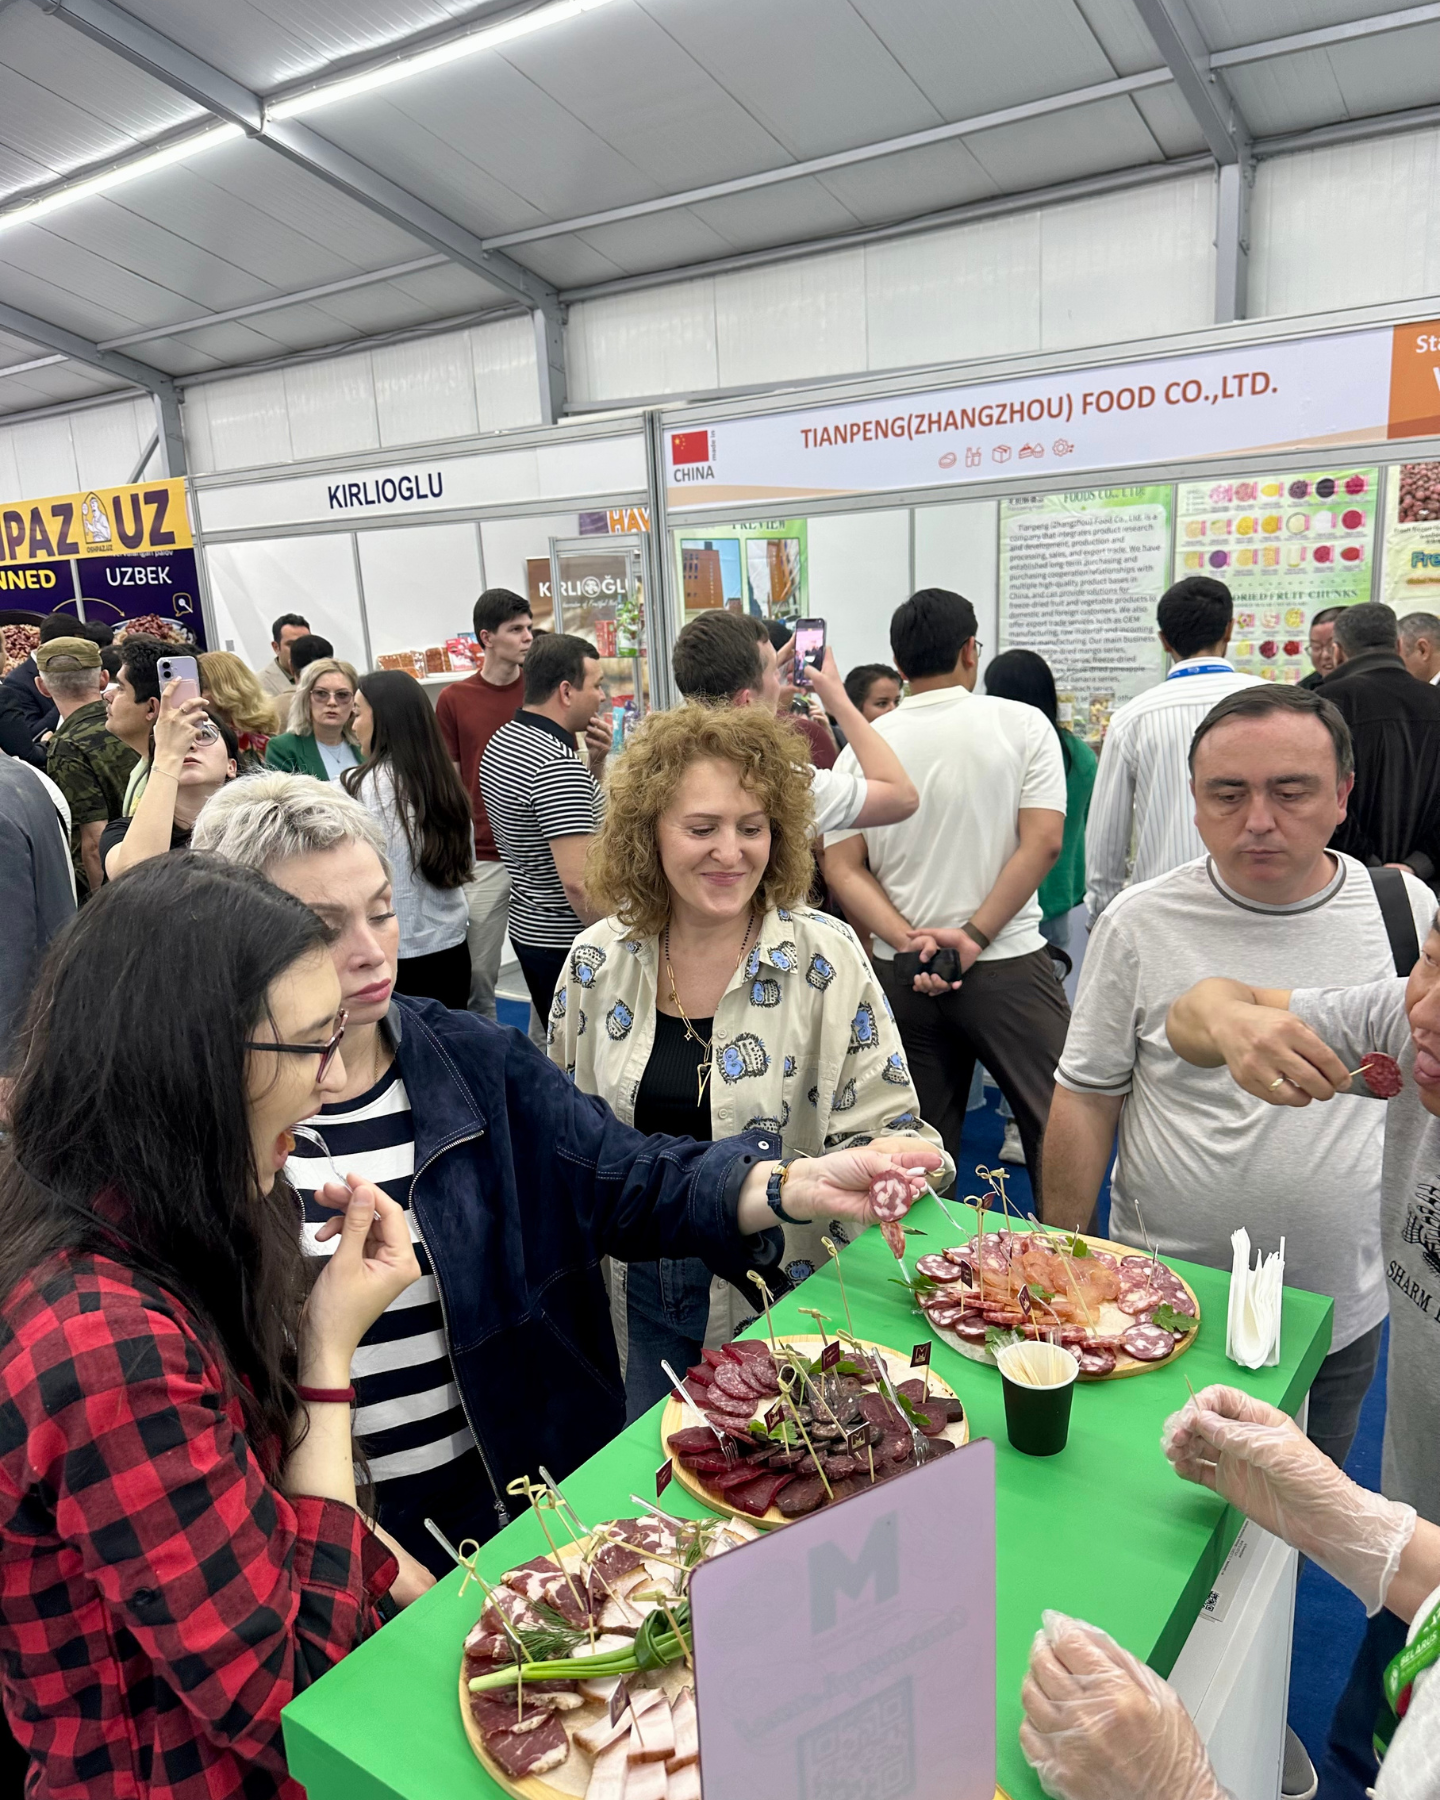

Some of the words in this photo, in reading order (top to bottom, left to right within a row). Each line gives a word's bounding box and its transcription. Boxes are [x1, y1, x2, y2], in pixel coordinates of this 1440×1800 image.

[801, 393, 1073, 449] TIANPENG(ZHANGZHOU)
[1082, 386, 1156, 415] FOOD
[710, 430, 716, 438] in
[674, 465, 715, 482] CHINA
[328, 471, 443, 509] KIRLIOGLU
[0, 502, 80, 562] PAZ
[112, 488, 176, 550] UZ
[1093, 527, 1121, 536] product
[1122, 523, 1154, 532] research
[1071, 538, 1109, 548] production
[1083, 548, 1106, 557] export
[1142, 544, 1161, 552] have
[1009, 561, 1048, 571] established
[1123, 555, 1138, 563] and
[106, 566, 172, 586] UZBEK
[1009, 572, 1047, 581] purchasing
[1009, 582, 1037, 590] multiple
[1080, 578, 1107, 587] product
[1059, 589, 1085, 598] provide
[1115, 595, 1148, 604] products
[1308, 589, 1358, 599] CHUNKS
[1025, 620, 1047, 628] export
[1123, 635, 1156, 643] business
[1387, 1260, 1432, 1312] SHARM
[1400, 1630, 1438, 1667] BELARUS
